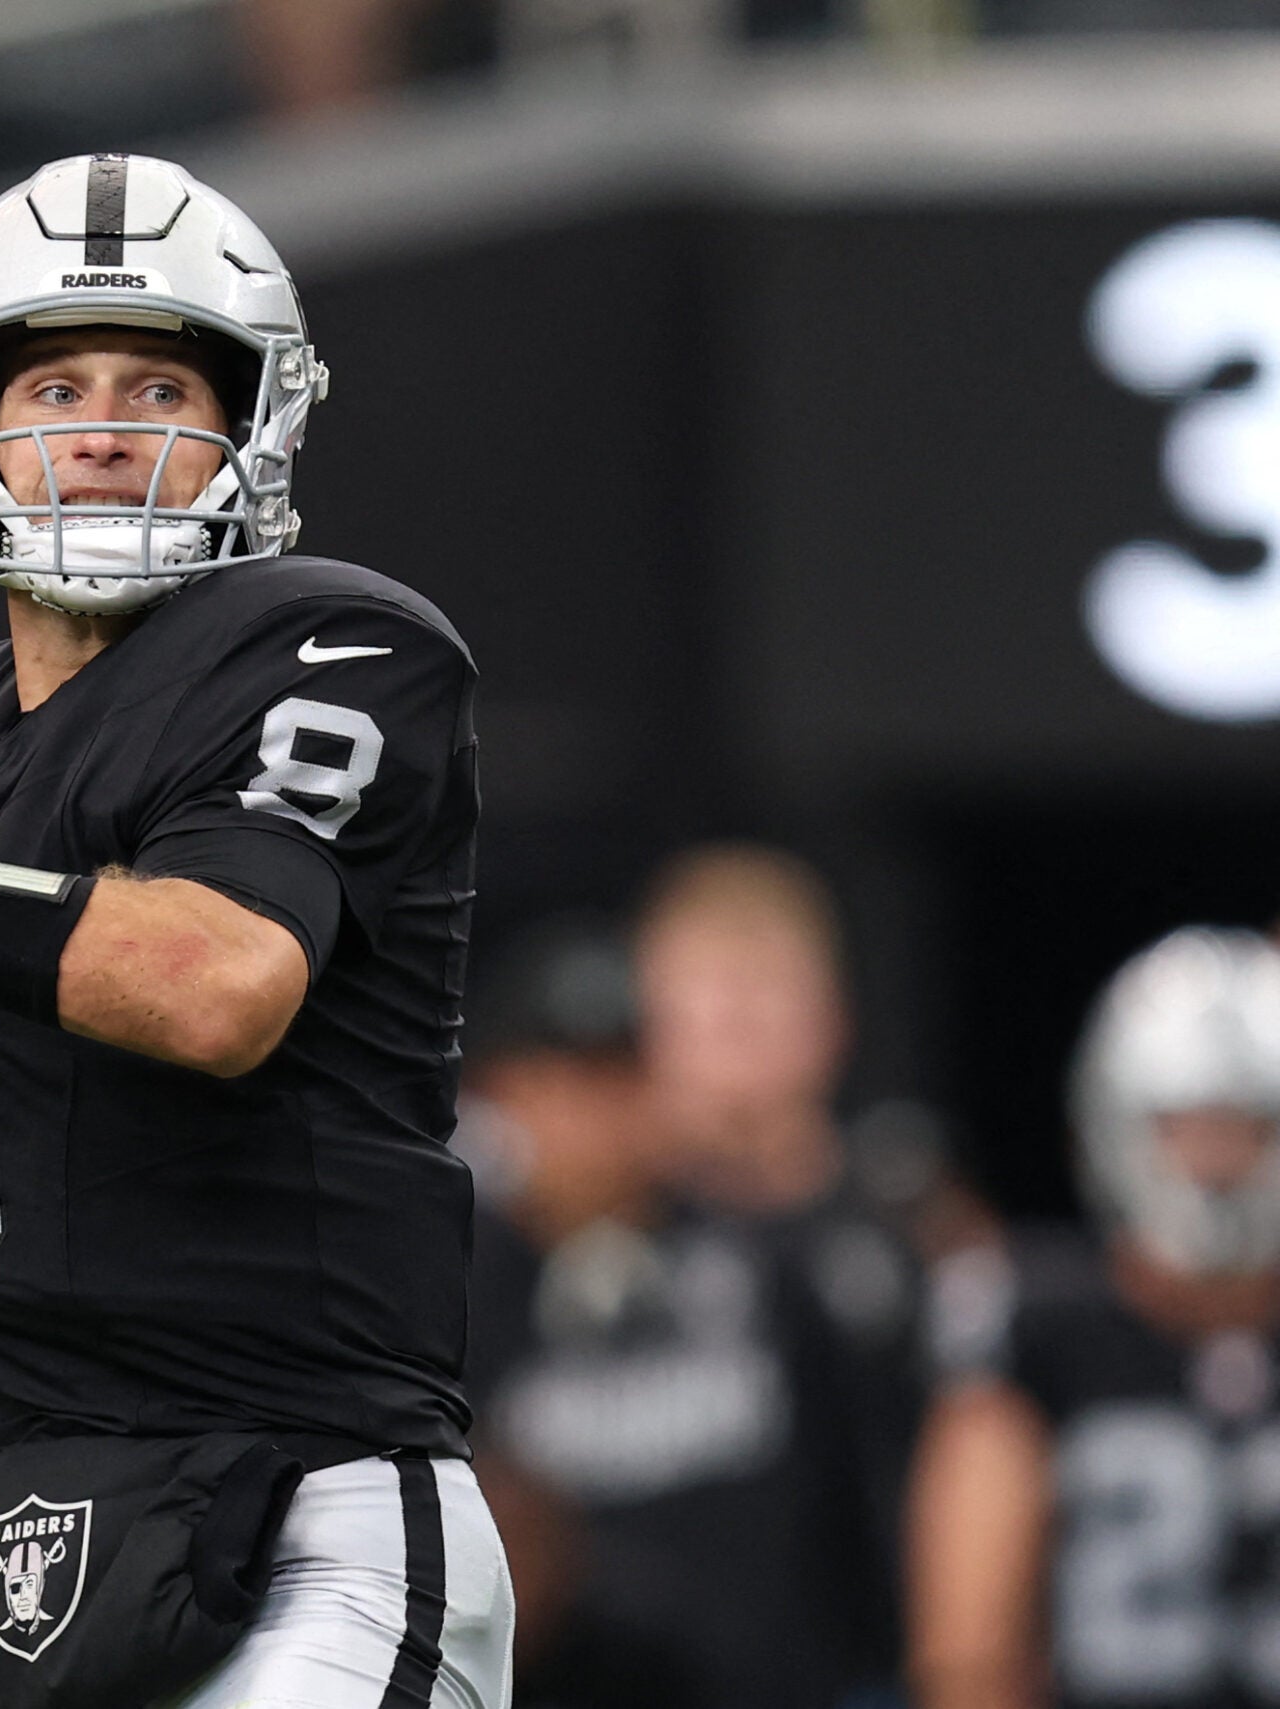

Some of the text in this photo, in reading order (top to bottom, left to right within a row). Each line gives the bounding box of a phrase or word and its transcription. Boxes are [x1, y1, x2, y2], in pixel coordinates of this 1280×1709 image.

[61, 273, 147, 289] RAIDERS
[1082, 218, 1280, 722] 3
[236, 697, 385, 840] 8
